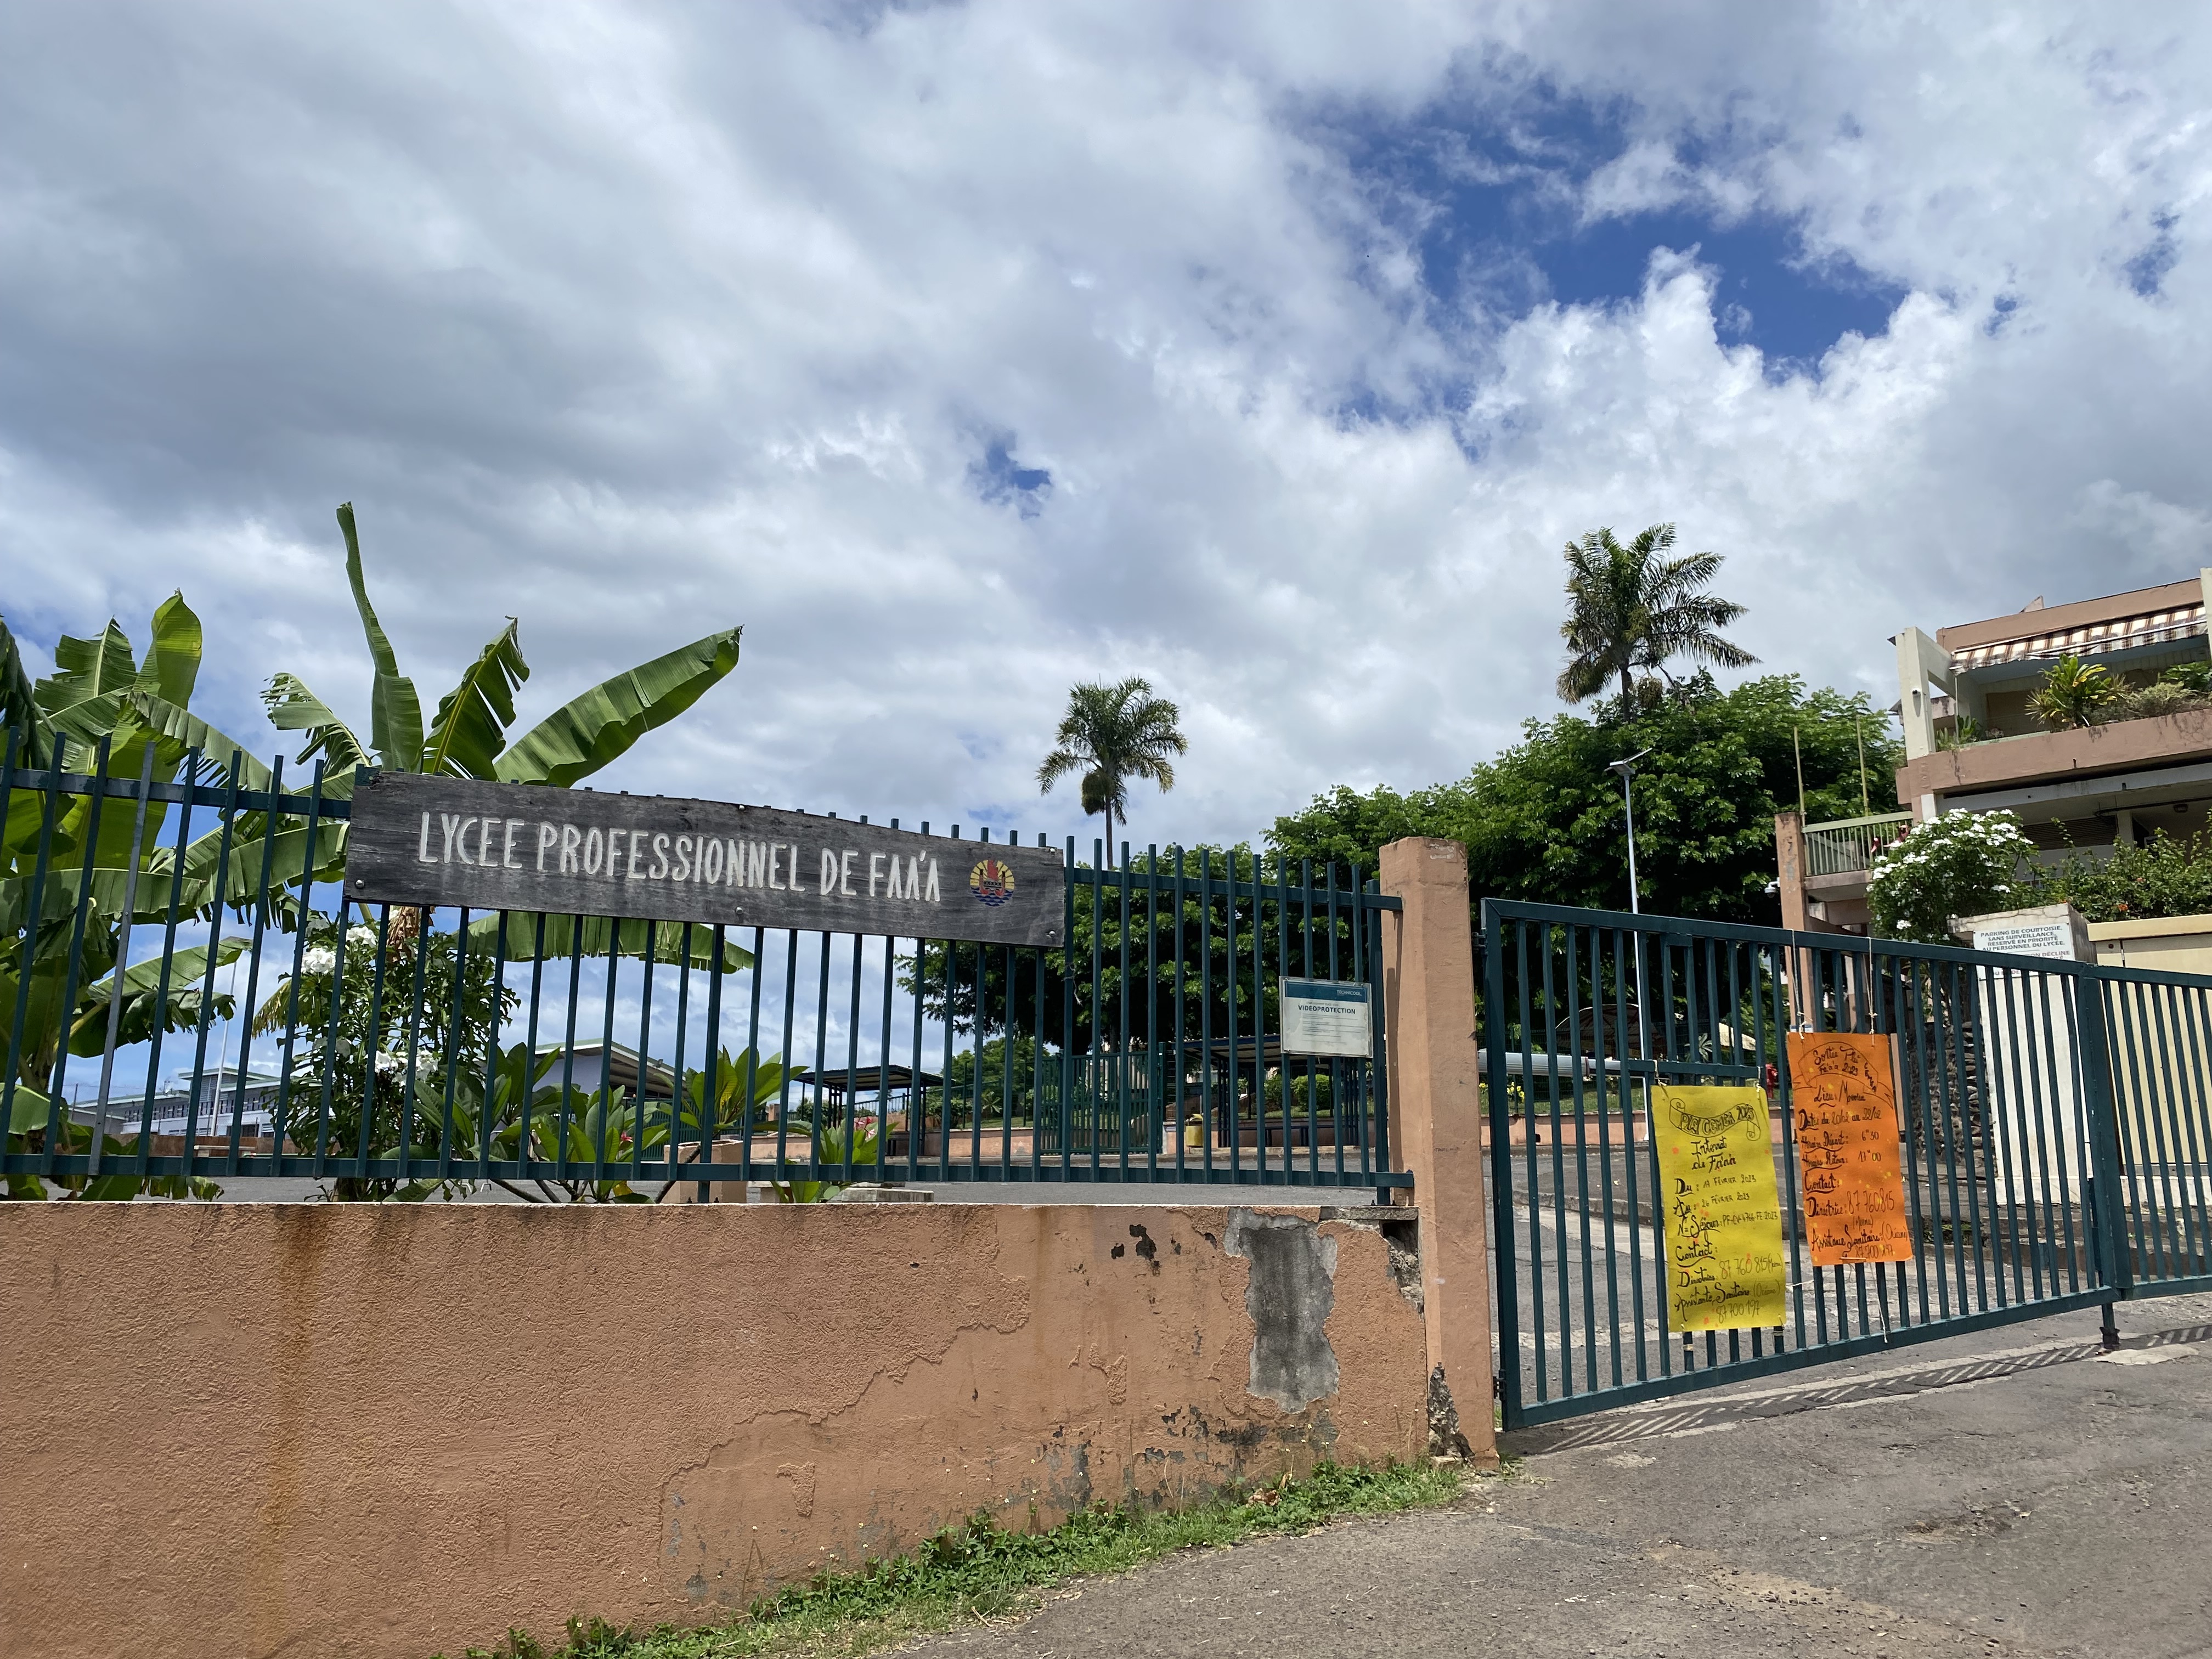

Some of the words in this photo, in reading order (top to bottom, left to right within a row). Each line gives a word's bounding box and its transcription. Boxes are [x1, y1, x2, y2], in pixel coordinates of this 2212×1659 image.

[419, 811, 525, 868] LYCEE
[537, 821, 805, 892] PROFESSIONNEL
[820, 848, 859, 896] DE
[1298, 1005, 1356, 1014] VIDÉOPROTECTION
[1842, 1062, 1858, 1076] 2023
[1862, 1106, 1882, 1120] 22/02
[1741, 1173, 1757, 1184] 2023
[1702, 1199, 1709, 1207] 26
[1737, 1192, 1750, 1201] 2023
[1719, 1260, 1731, 1280] 87
[1734, 1258, 1752, 1276] 760
